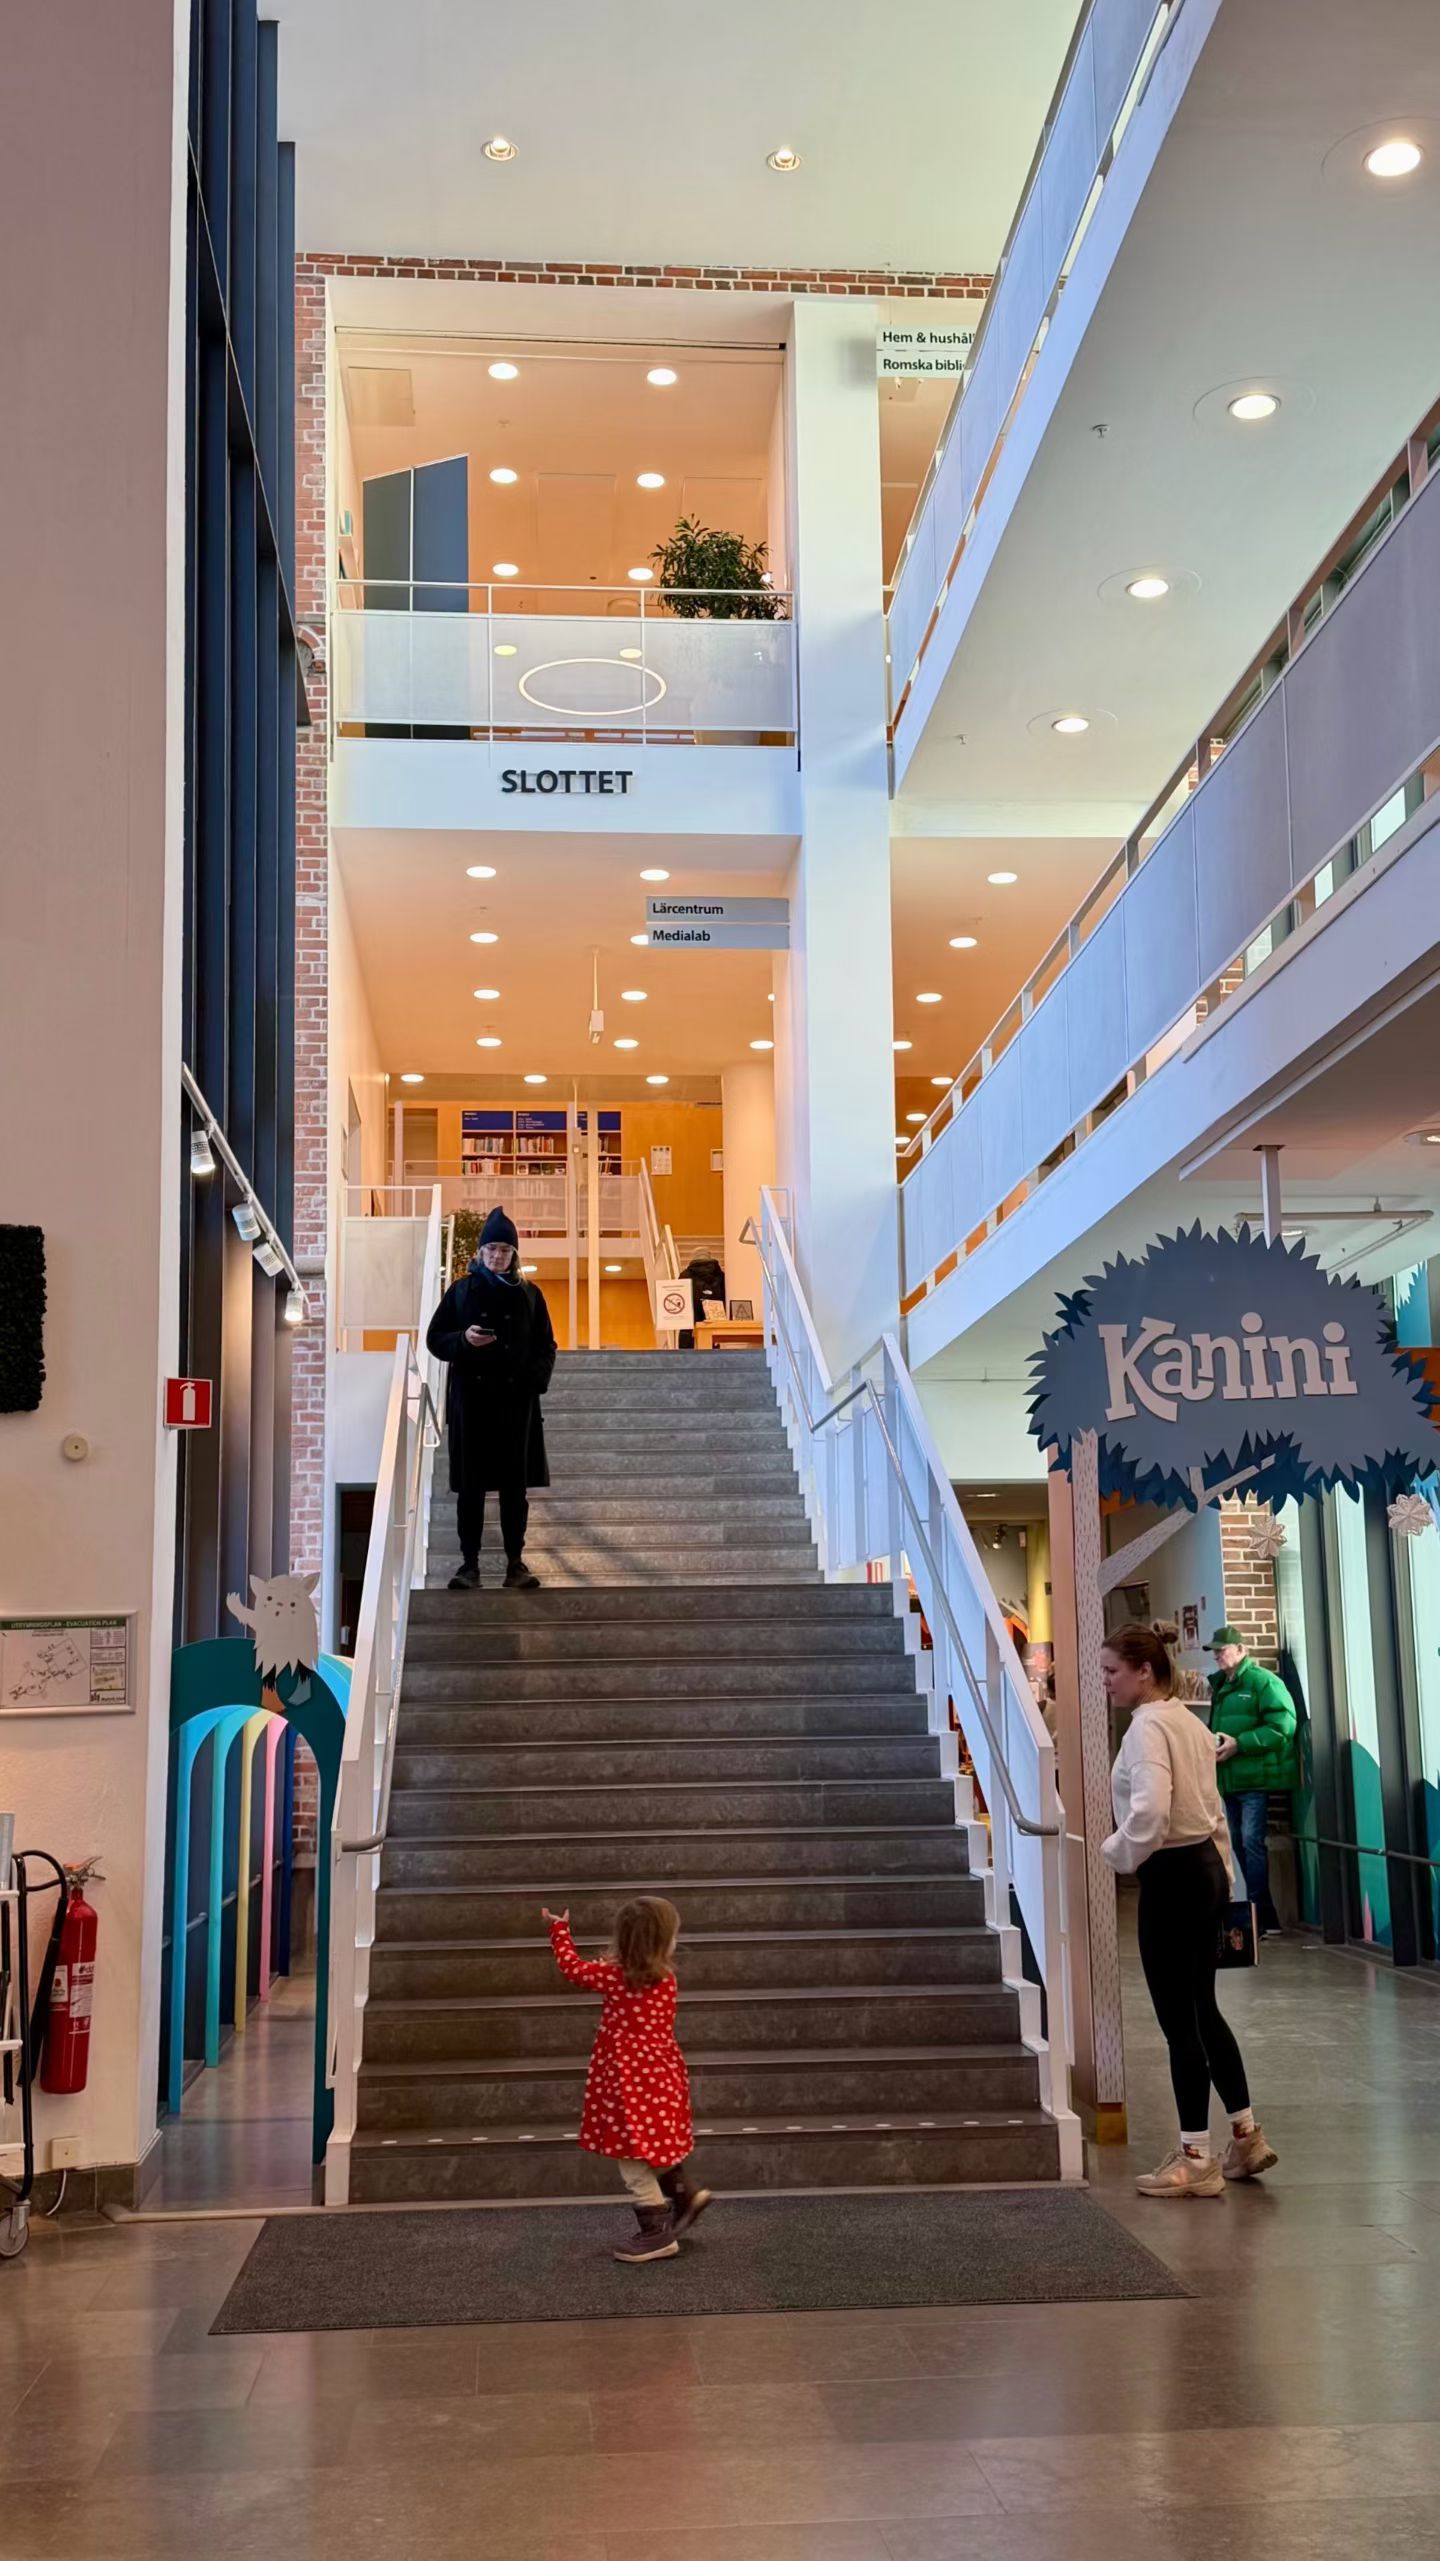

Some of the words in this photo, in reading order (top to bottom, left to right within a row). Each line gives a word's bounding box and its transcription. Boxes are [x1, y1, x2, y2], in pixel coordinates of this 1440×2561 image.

[883, 331, 913, 343] Hem
[916, 332, 926, 343] &
[930, 332, 975, 344] hushål
[883, 358, 933, 370] Romska
[935, 359, 964, 371] bibli
[501, 769, 633, 794] SLOTTET
[652, 902, 724, 915] Lärcentrum
[652, 929, 711, 942] Medialab
[1097, 1311, 1359, 1423] Kanini
